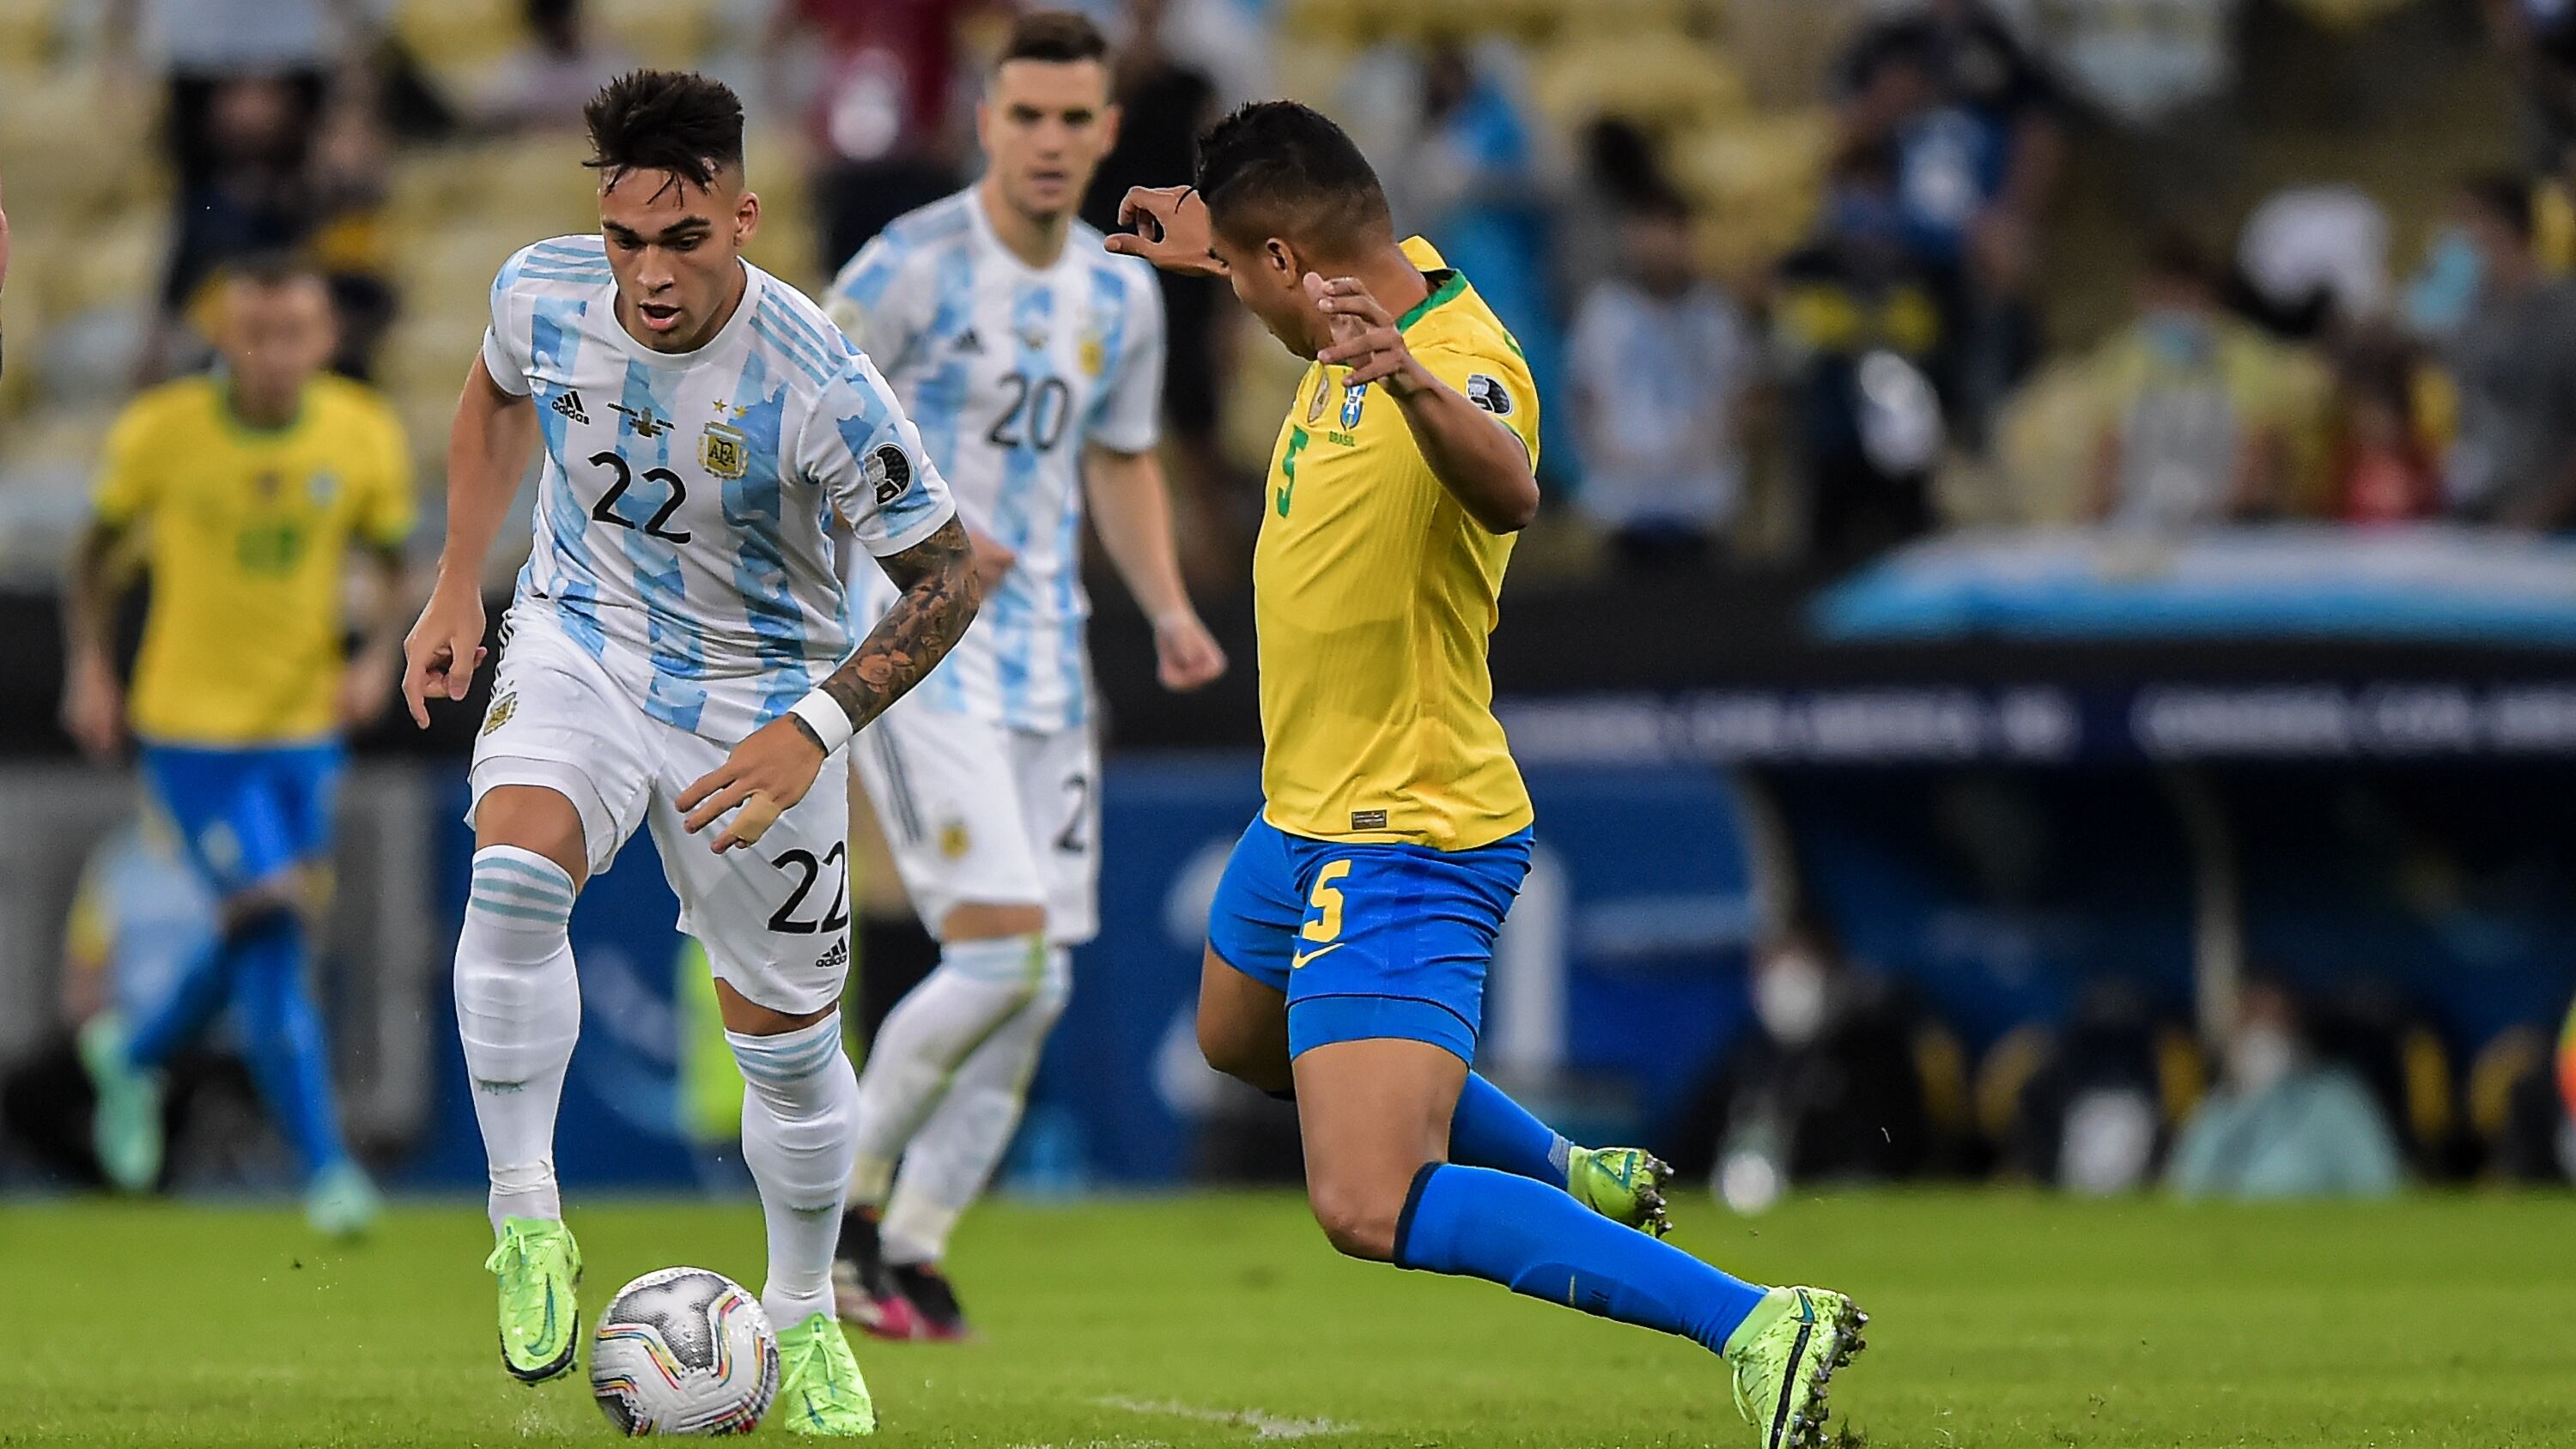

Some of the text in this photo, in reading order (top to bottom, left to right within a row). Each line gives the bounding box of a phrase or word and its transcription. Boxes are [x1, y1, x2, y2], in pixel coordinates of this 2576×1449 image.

[551, 400, 590, 426] adidas
[708, 437, 736, 466] AFA
[987, 371, 1068, 452] 20
[587, 451, 691, 544] 22
[1276, 426, 1309, 518] 5
[768, 840, 848, 935] 22
[1302, 859, 1352, 943] 5
